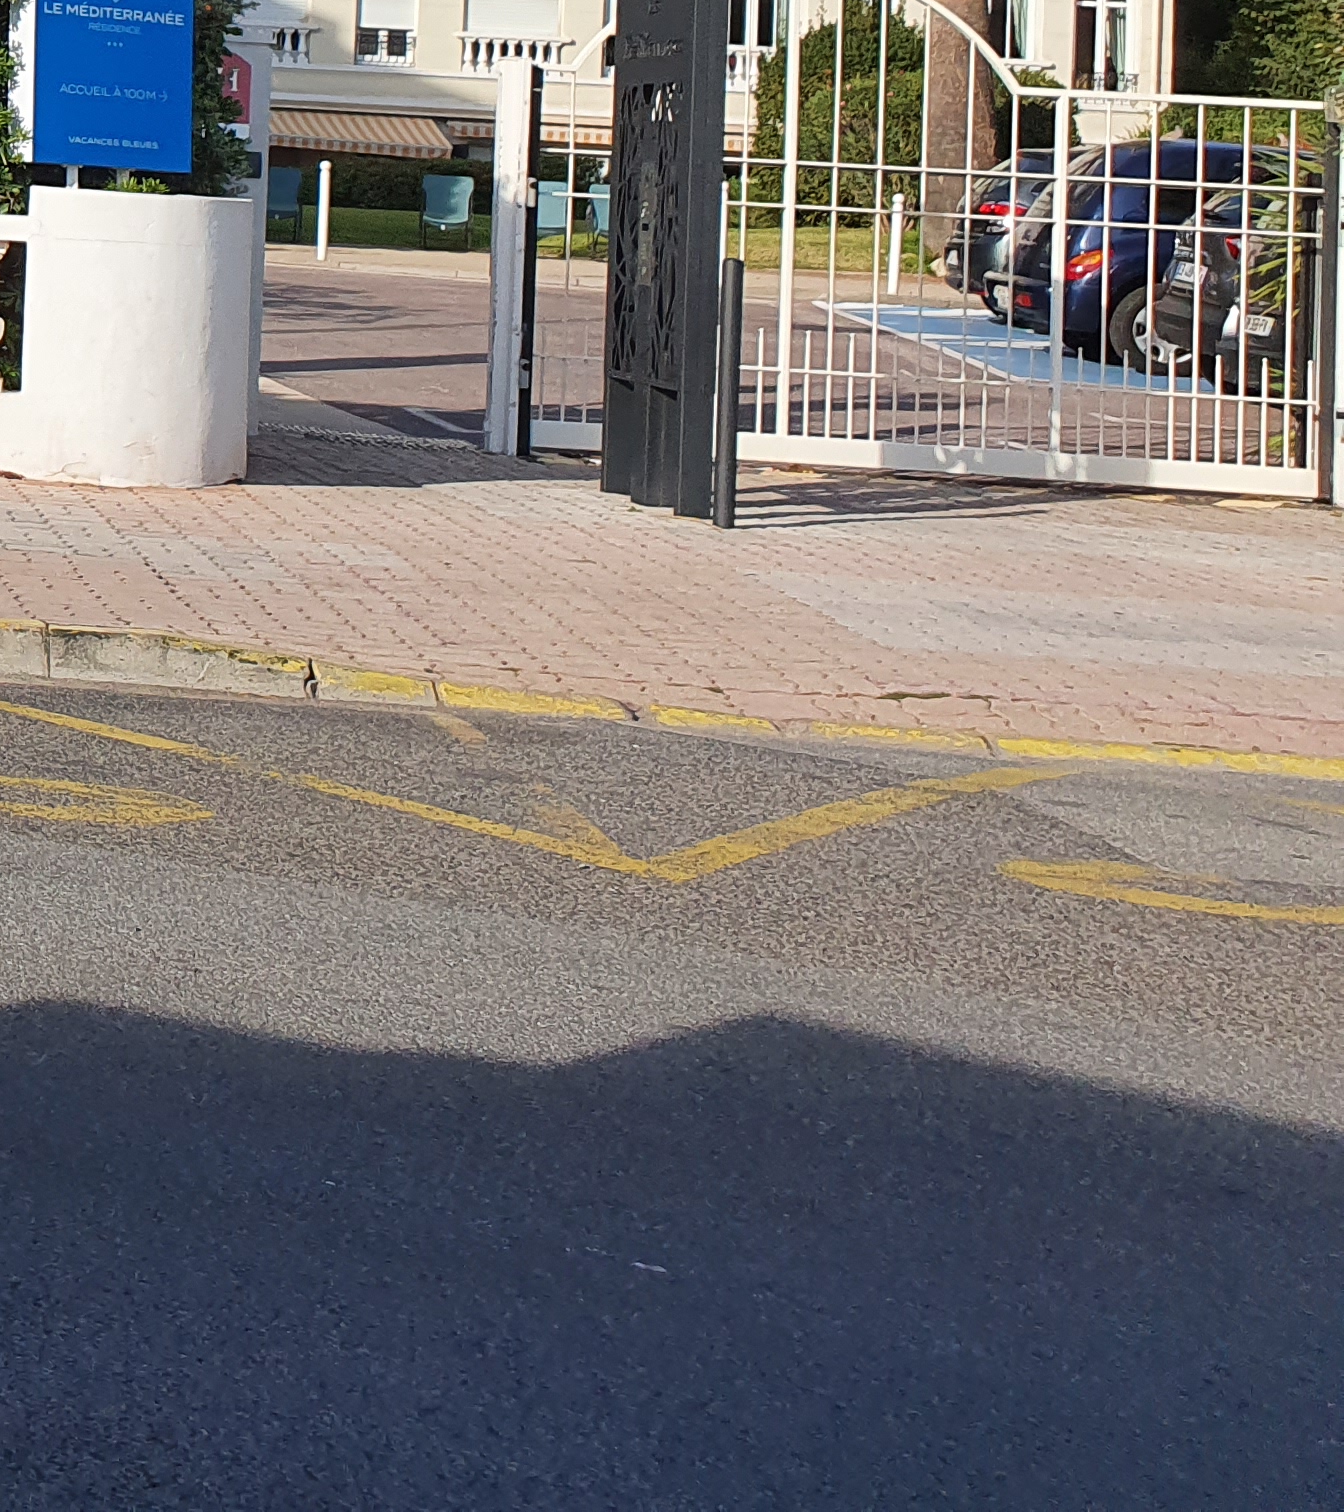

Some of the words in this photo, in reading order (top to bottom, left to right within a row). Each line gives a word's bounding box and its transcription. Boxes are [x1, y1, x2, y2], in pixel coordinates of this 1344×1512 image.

[43, 1, 63, 15] LE
[65, 1, 185, 26] MÉDITERRANÉE
[59, 83, 111, 97] ACCUEIL
[113, 85, 122, 98] À
[68, 136, 120, 147] VACANCES
[122, 137, 159, 150] BLEUES
